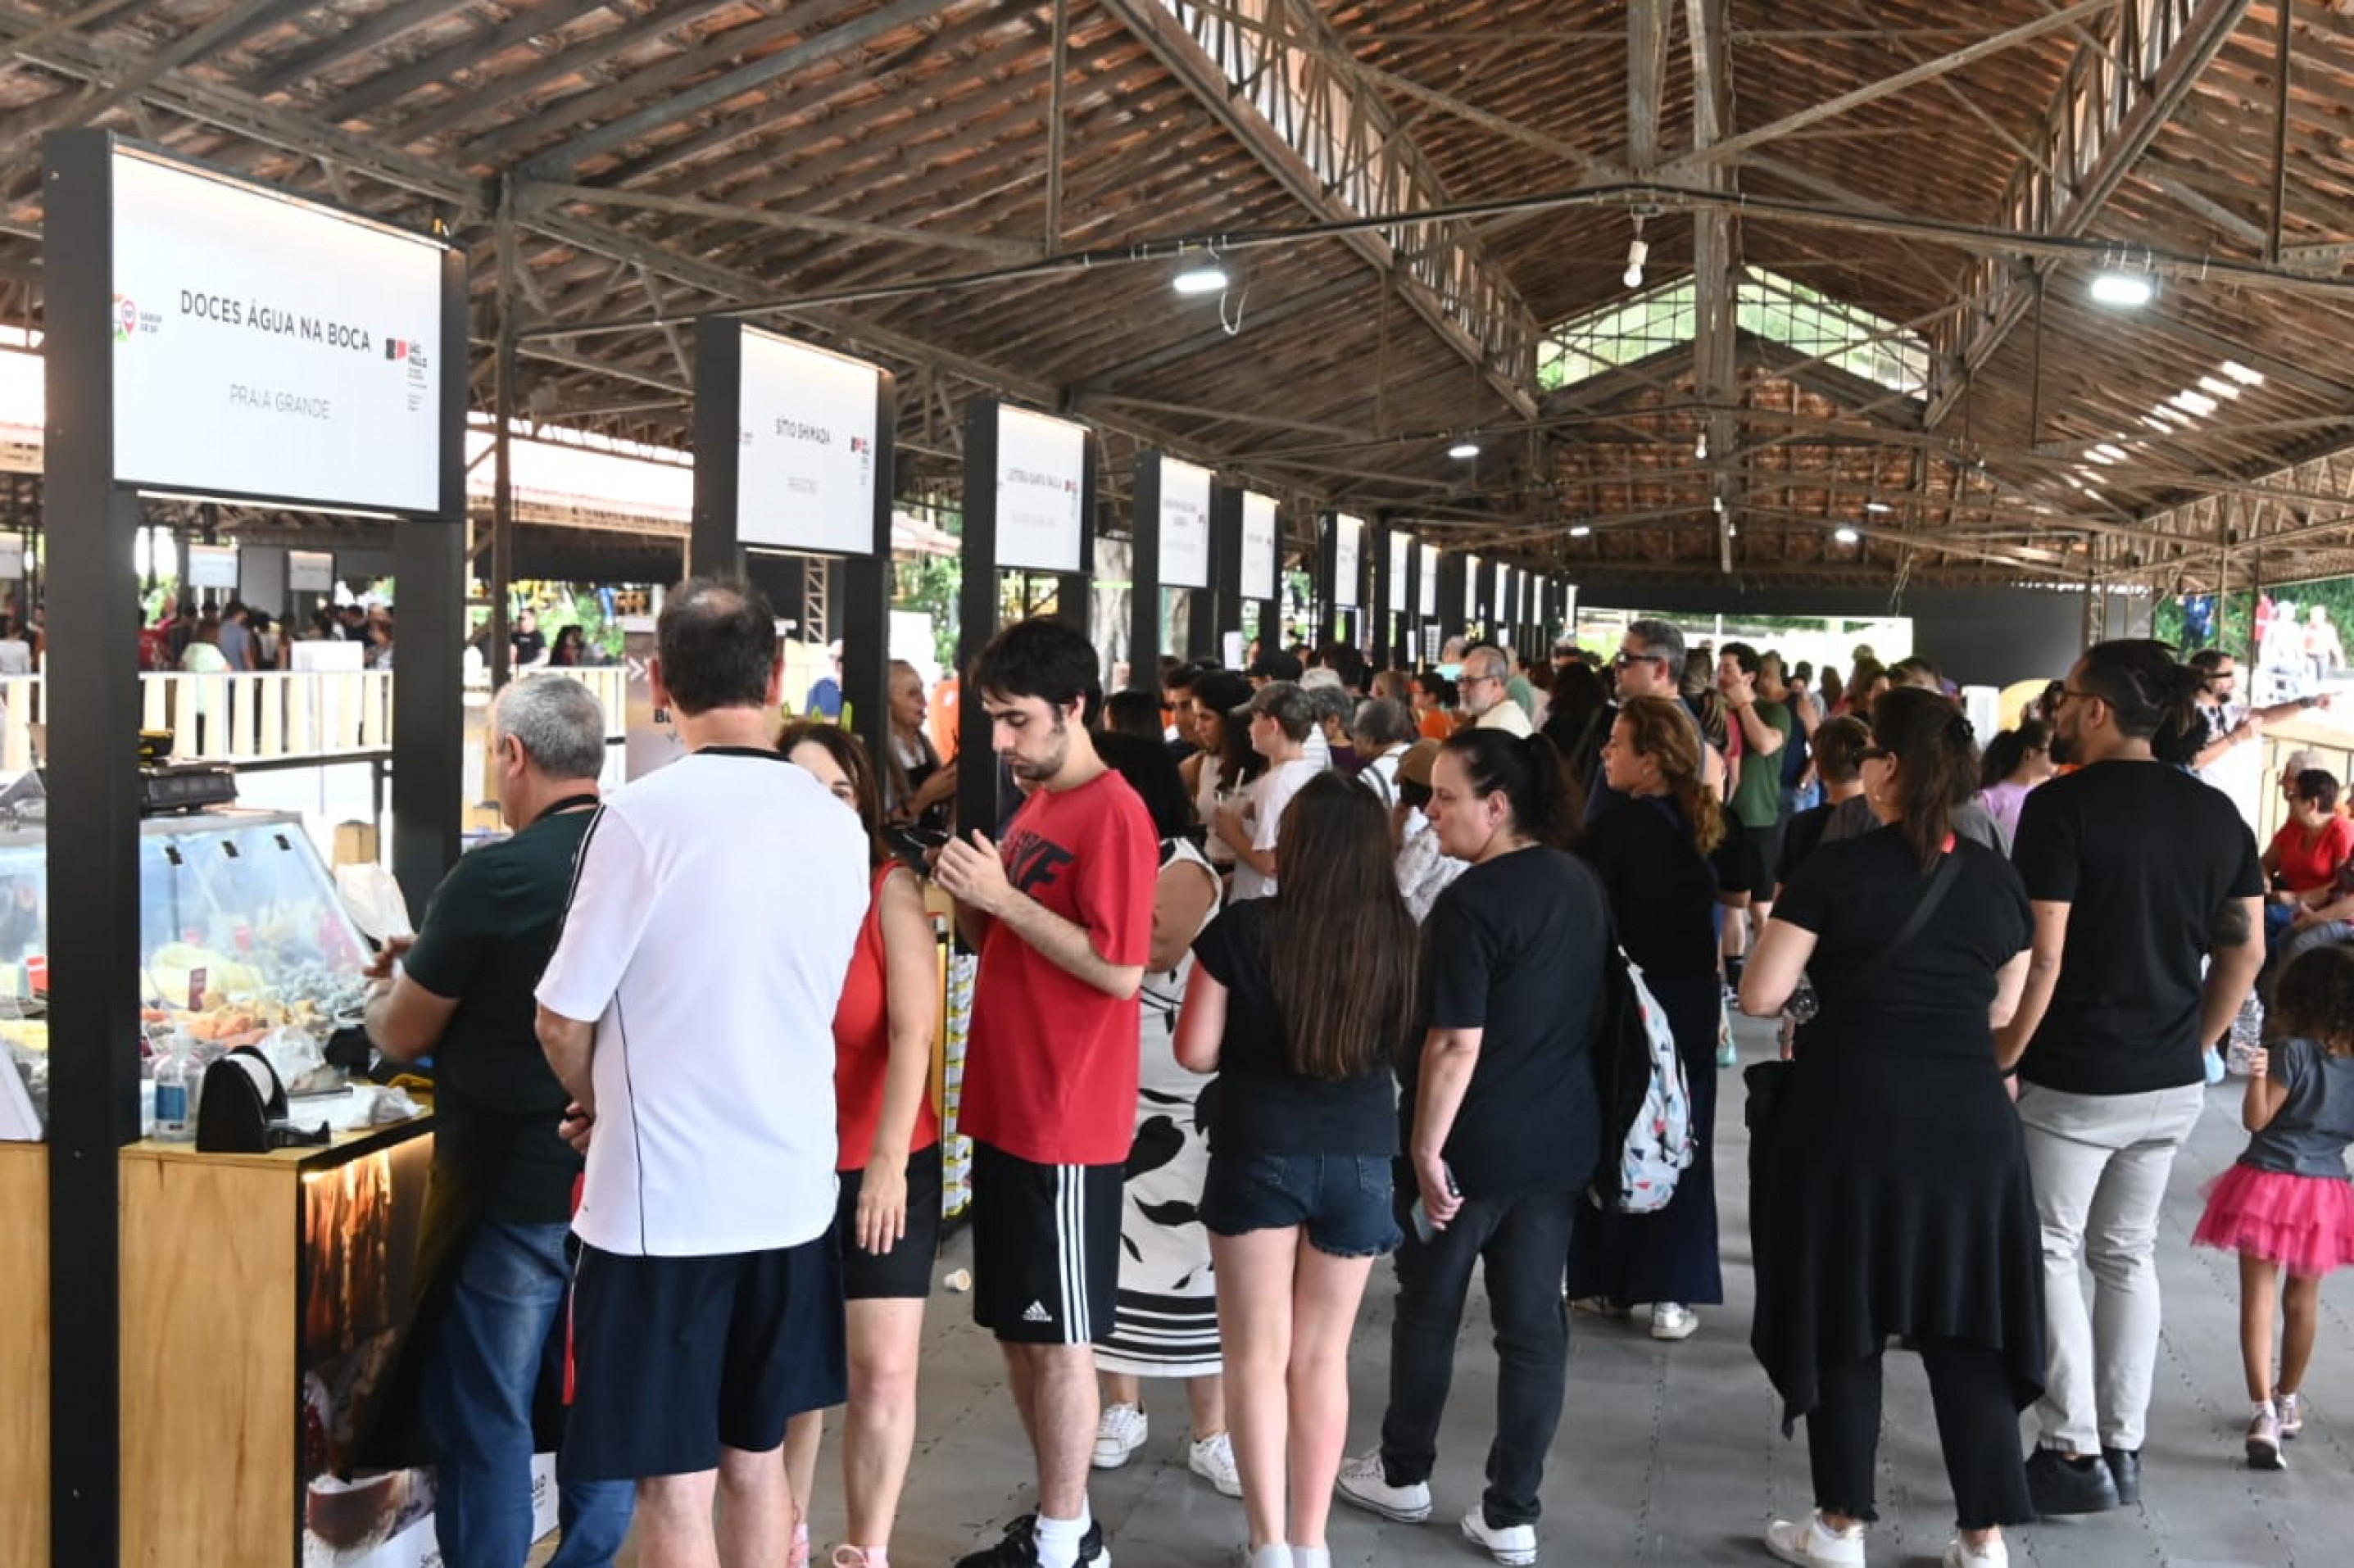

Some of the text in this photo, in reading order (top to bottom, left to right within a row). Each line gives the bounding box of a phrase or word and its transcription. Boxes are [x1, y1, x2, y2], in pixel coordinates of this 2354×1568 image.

[180, 289, 242, 324] DOCES
[247, 298, 295, 336] ÁGUA
[301, 316, 324, 342] NA
[329, 323, 372, 353] BOCA
[230, 383, 331, 420] PRAIA GRANDE
